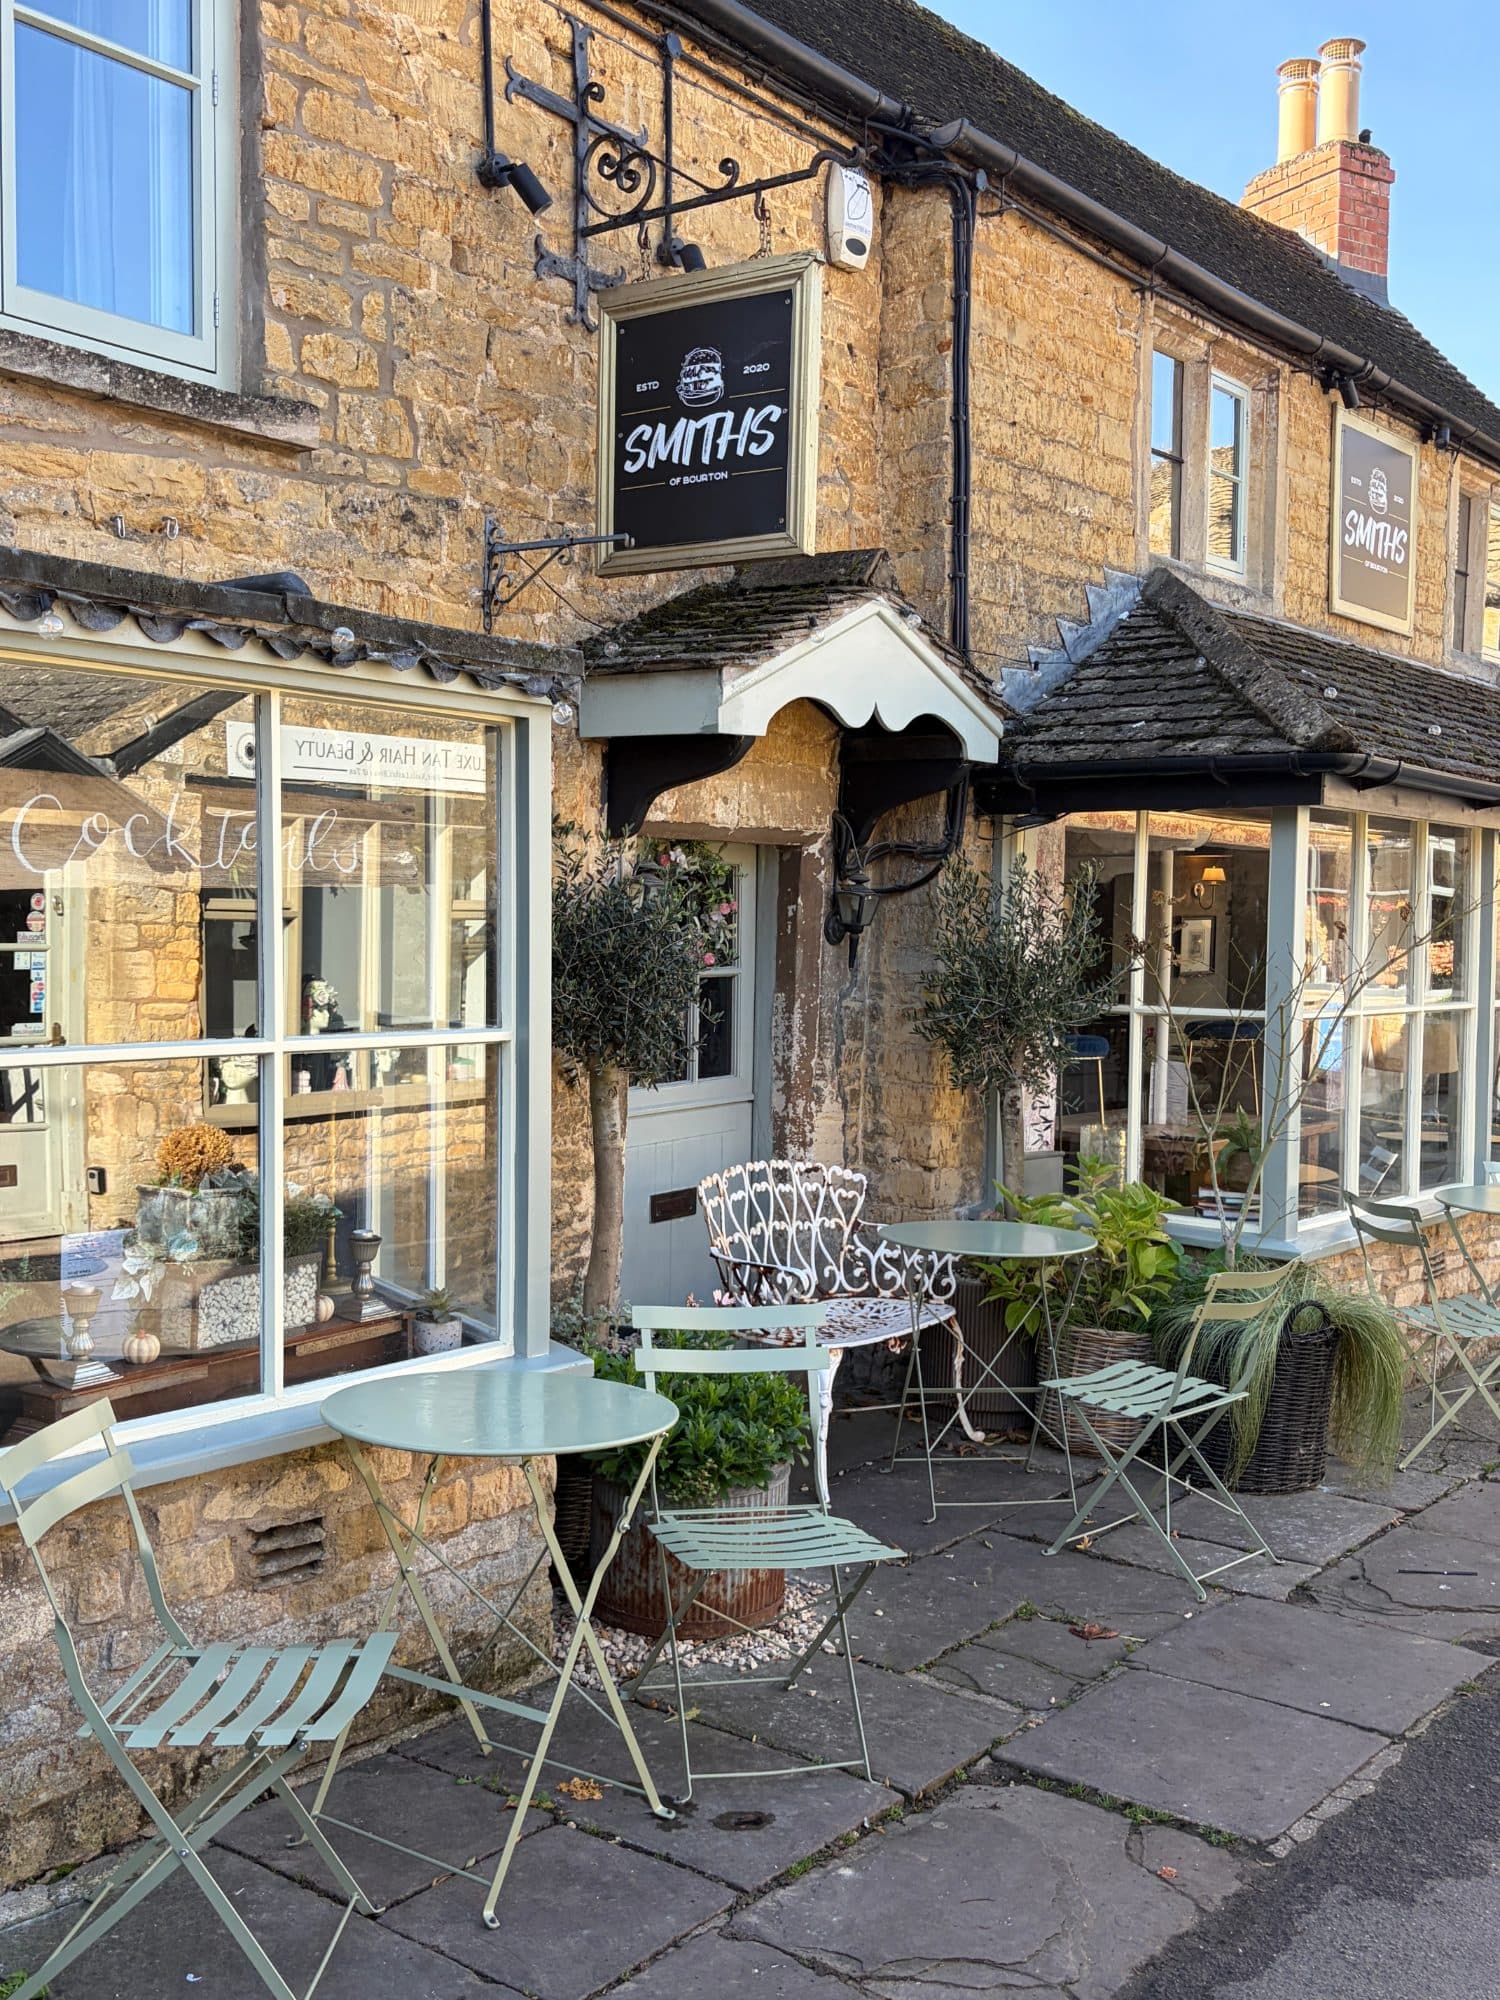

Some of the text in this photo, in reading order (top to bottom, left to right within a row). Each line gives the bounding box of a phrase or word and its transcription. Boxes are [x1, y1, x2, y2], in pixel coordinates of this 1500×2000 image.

[636, 363, 770, 392] ESTD 2020
[623, 405, 782, 474] SMITHS
[669, 471, 728, 487] OF BOURTON
[1345, 510, 1408, 564] SMITHS
